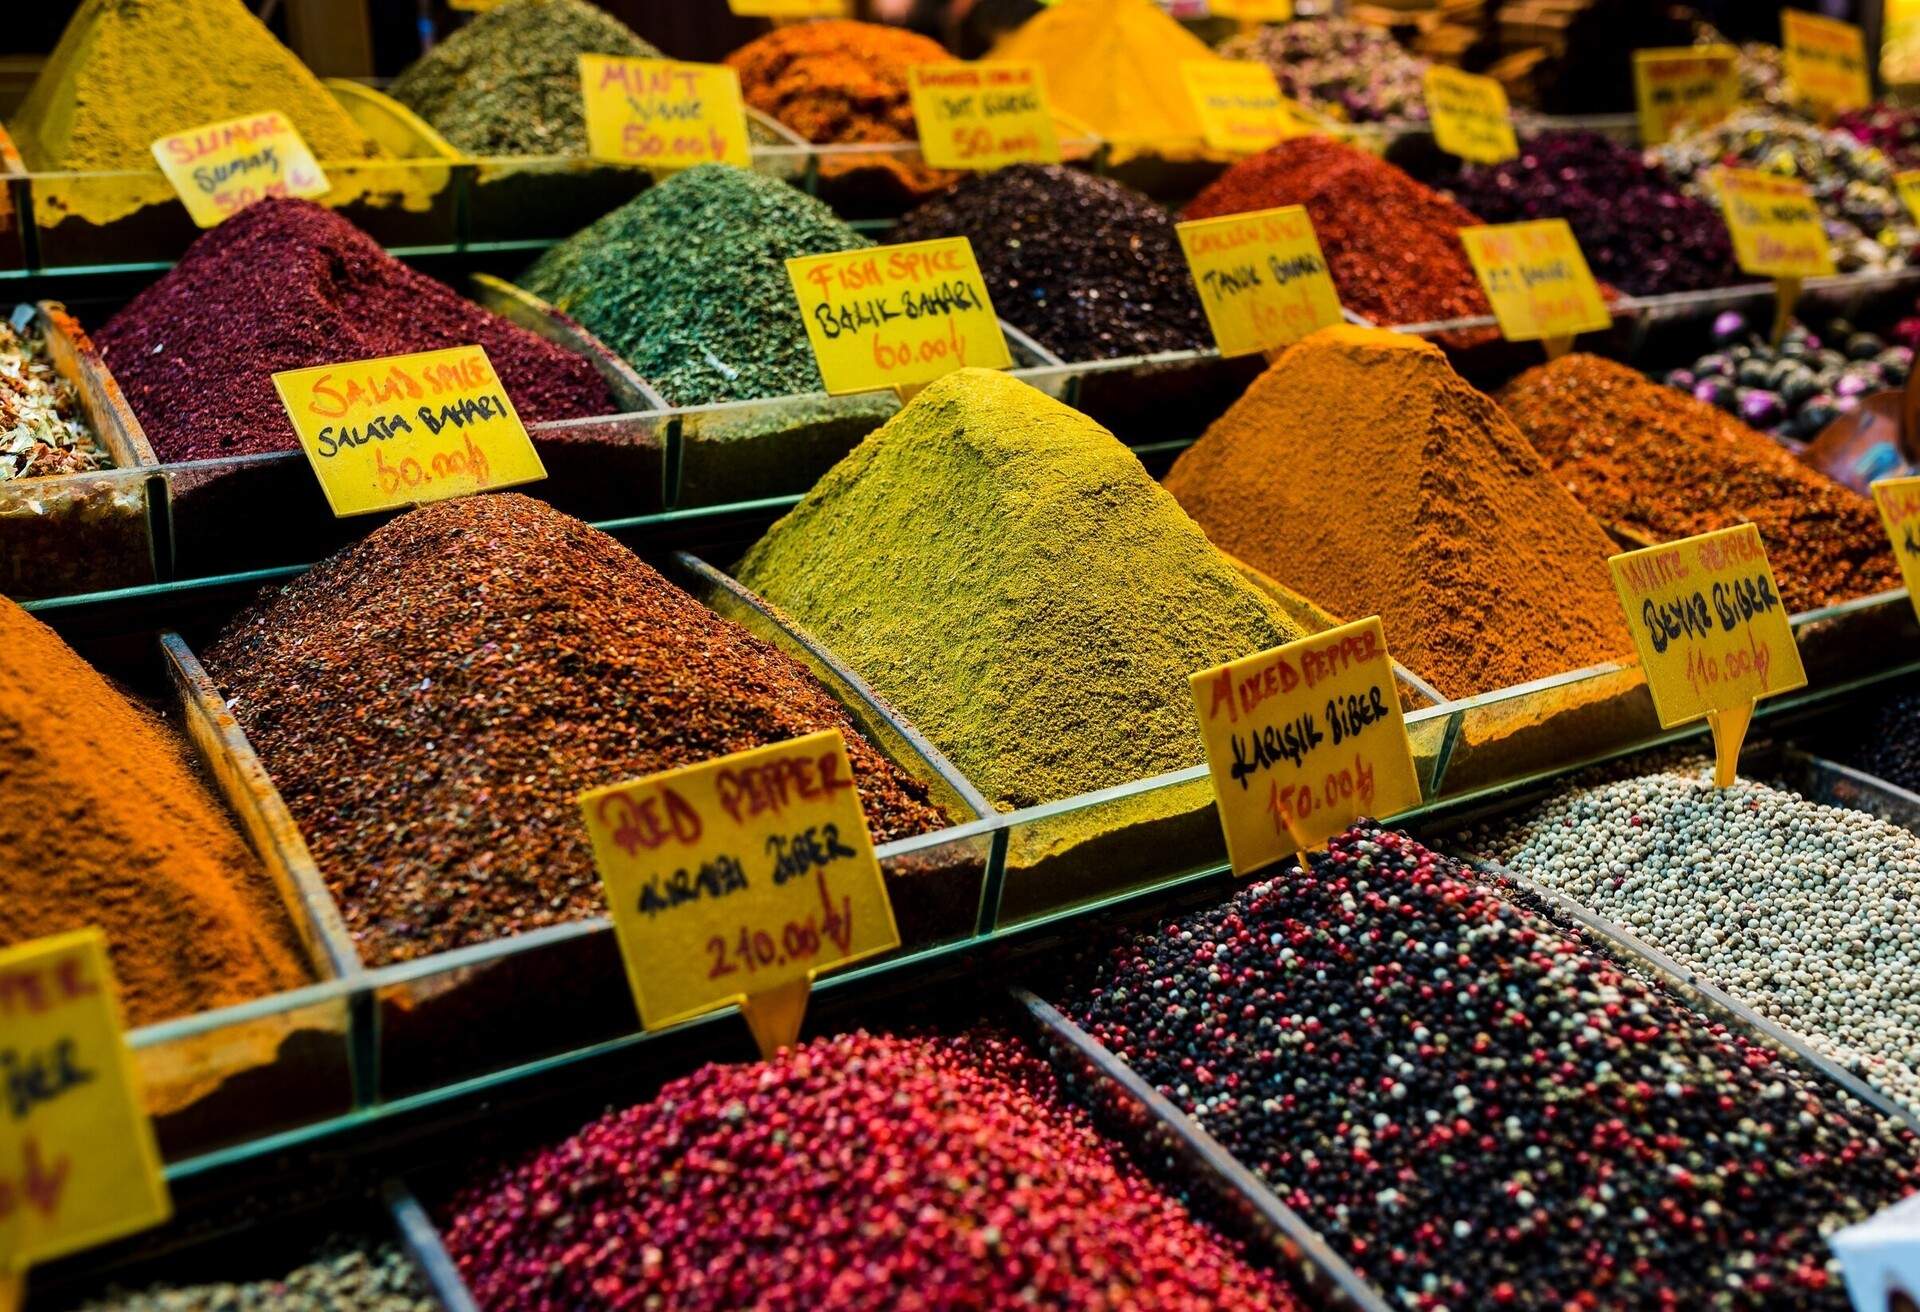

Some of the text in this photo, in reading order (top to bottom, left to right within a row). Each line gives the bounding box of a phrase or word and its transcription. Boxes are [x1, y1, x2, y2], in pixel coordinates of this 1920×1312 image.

[599, 63, 704, 97] MINT
[807, 249, 966, 302] FISH SPICE
[815, 300, 898, 338] BALIK
[318, 395, 508, 457] SALATA BAHARI
[1209, 630, 1386, 724] MIXED PEPPER
[597, 786, 703, 858] RED
